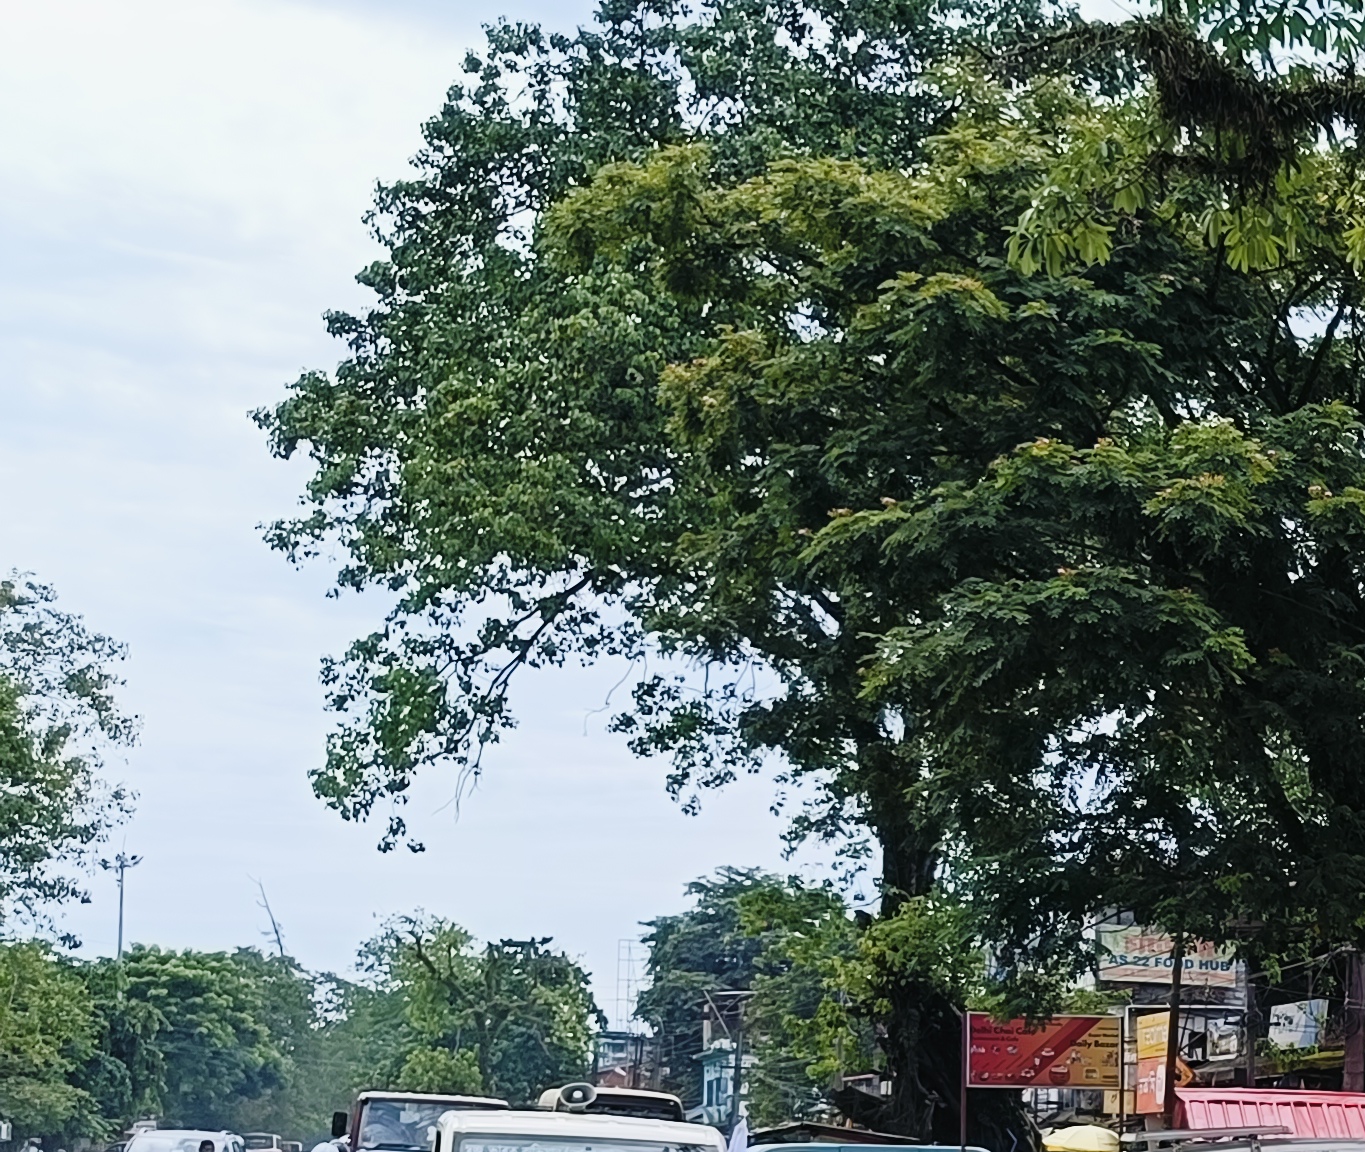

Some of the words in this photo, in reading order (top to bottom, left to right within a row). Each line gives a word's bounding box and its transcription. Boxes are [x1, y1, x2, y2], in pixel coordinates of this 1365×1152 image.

[1108, 954, 1128, 965] AS
[1133, 956, 1150, 967] 22
[1155, 957, 1194, 969] FOD
[1199, 960, 1230, 971] HUB
